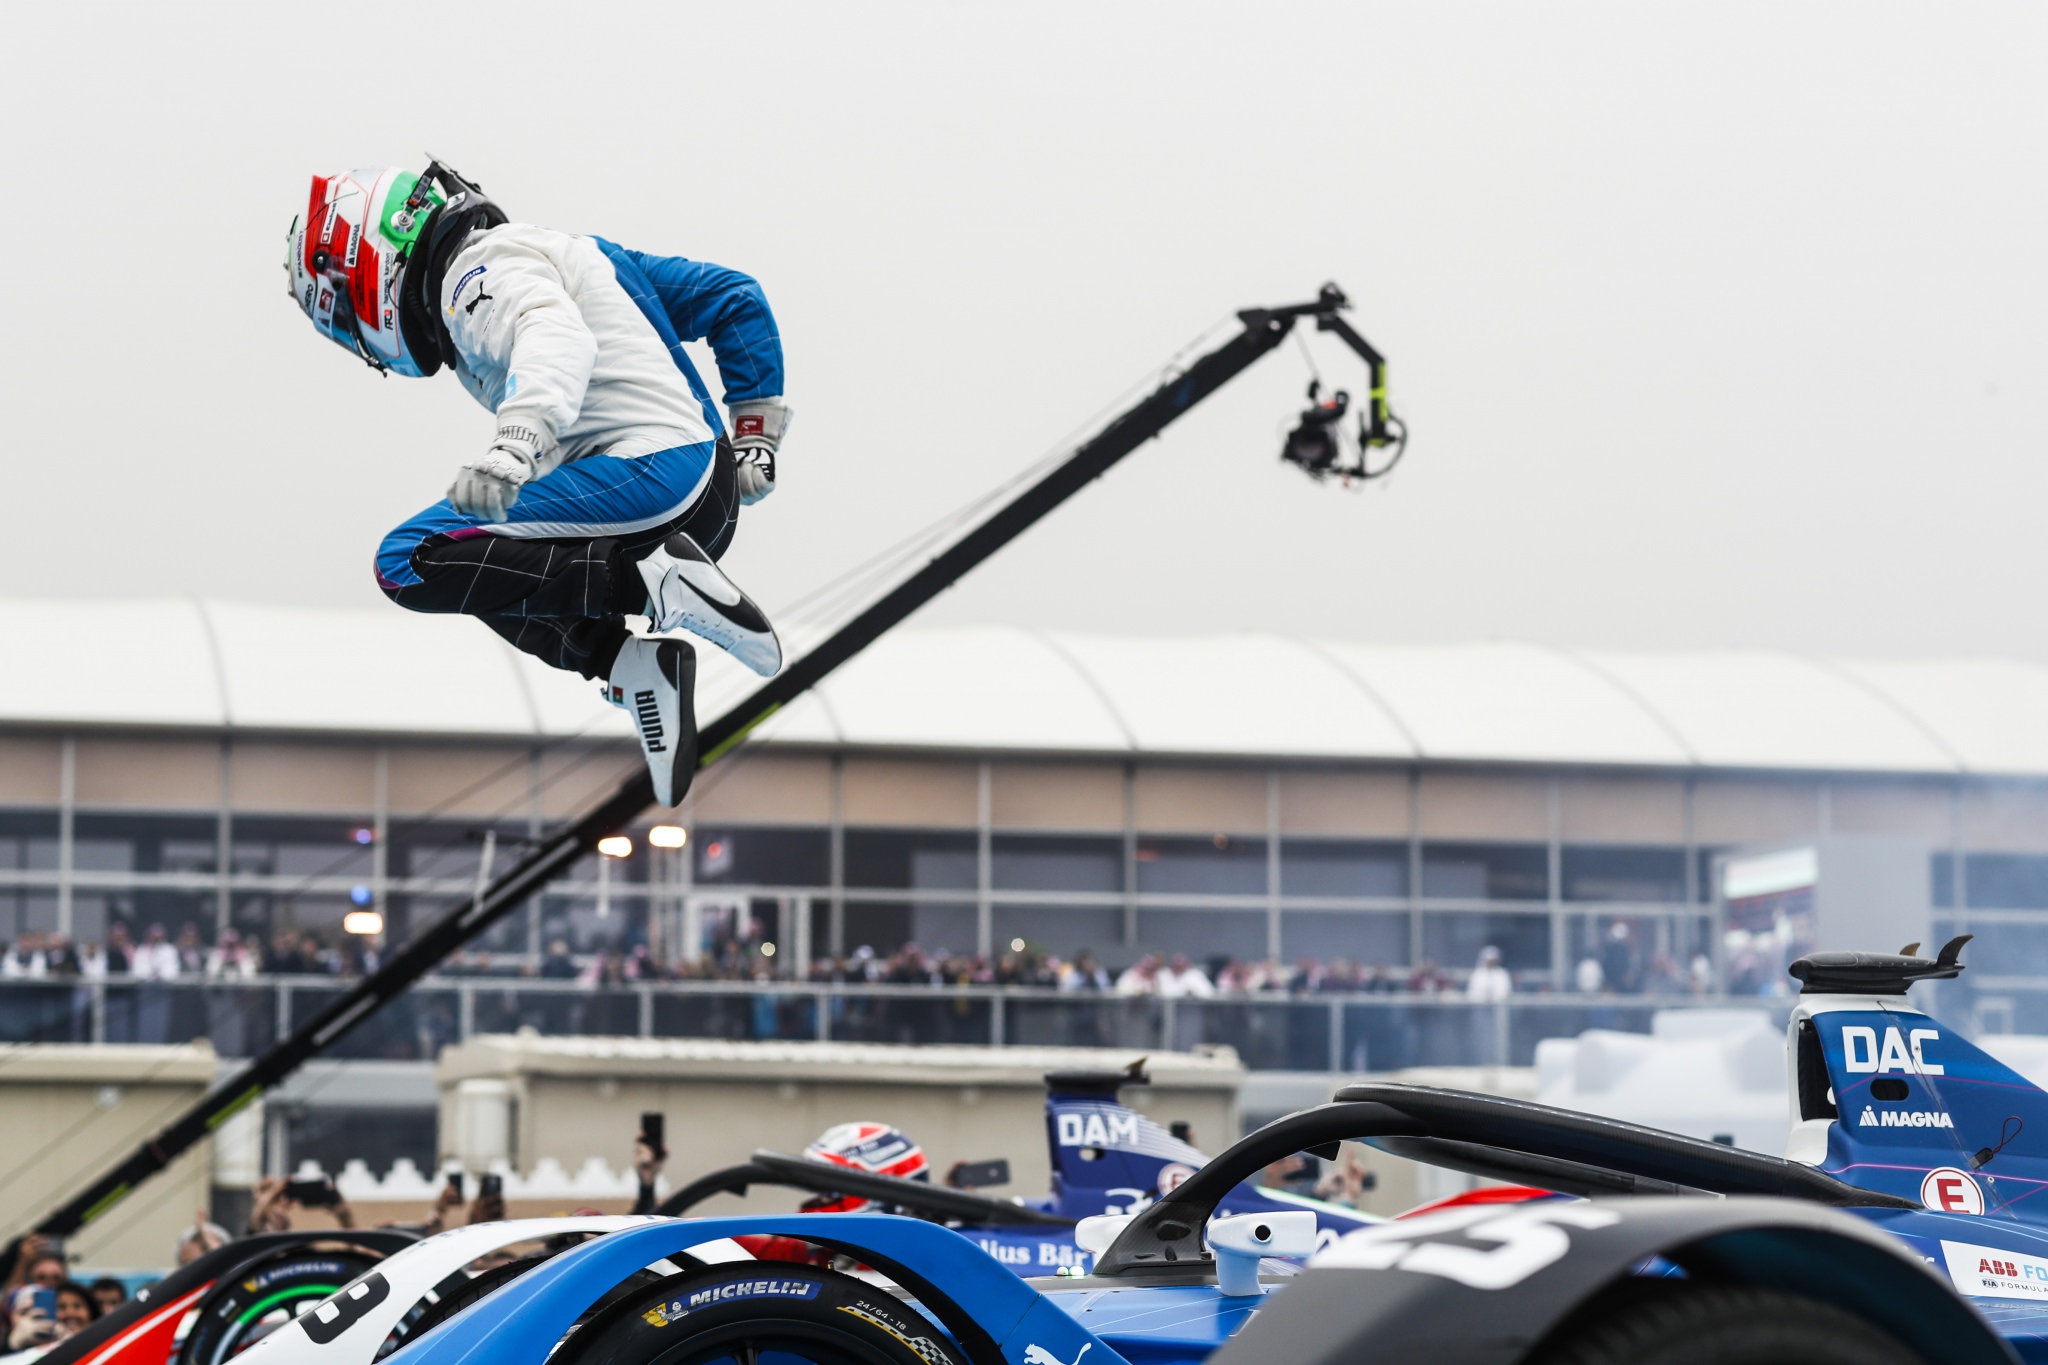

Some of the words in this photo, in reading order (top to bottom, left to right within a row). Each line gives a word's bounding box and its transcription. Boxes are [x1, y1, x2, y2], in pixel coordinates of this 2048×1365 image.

[349, 223, 360, 256] MAGNA
[634, 689, 667, 753] PUMA
[1842, 1026, 1945, 1076] DAC
[1058, 1113, 1139, 1146] DAM
[1881, 1111, 1954, 1128] MAGNA
[1936, 1178, 1969, 1214] E
[1979, 1258, 2018, 1277] ABB
[1982, 1280, 1997, 1288] FIA
[690, 1281, 810, 1307] MICHELIN
